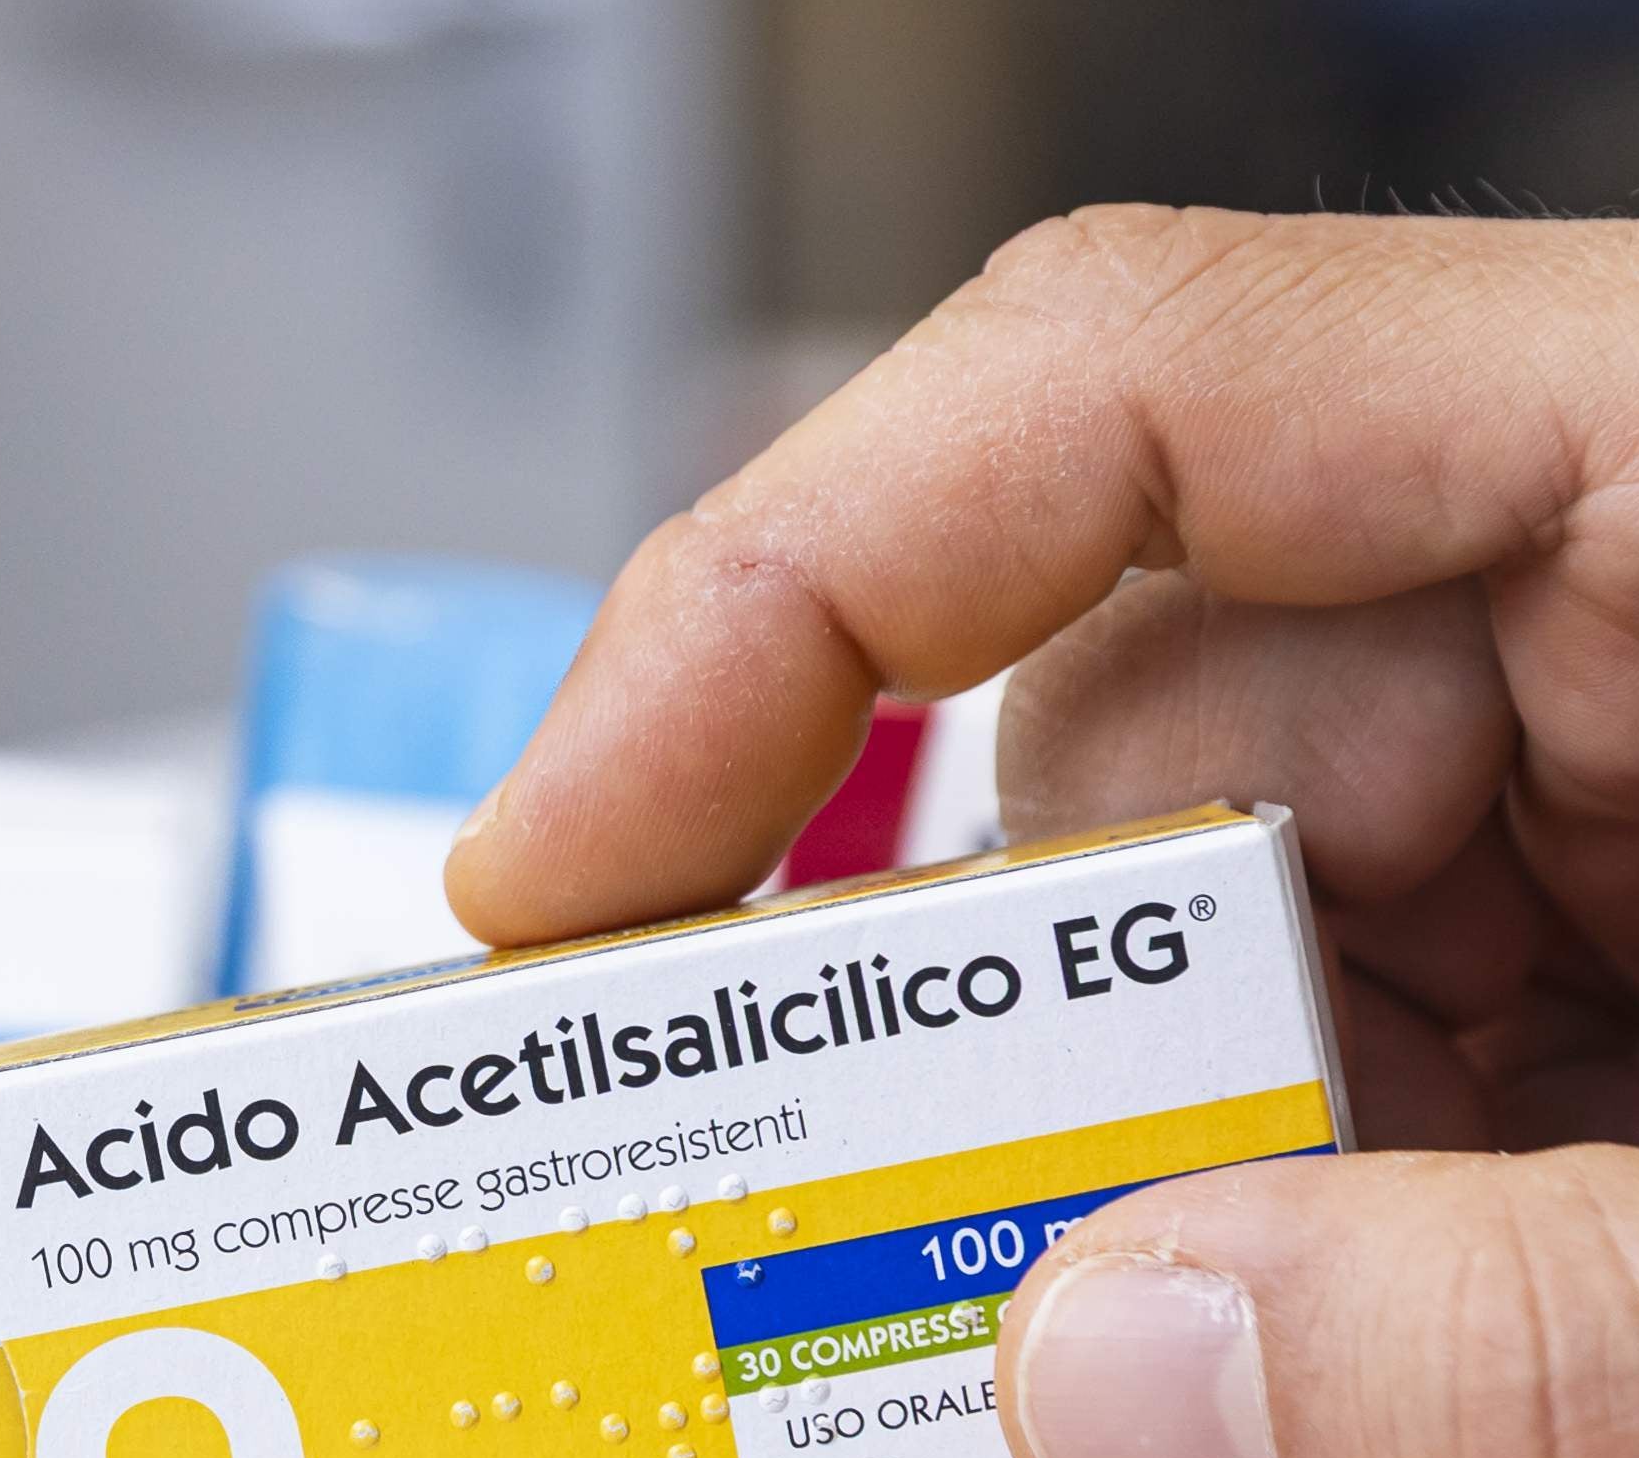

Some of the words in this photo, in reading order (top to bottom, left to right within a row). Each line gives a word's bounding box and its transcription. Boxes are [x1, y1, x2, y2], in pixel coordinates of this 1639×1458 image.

[16, 1088, 299, 1208] Acido
[336, 954, 1021, 1145] Acetilsalicilico
[32, 1238, 112, 1288] 100
[129, 1229, 199, 1271] mg
[214, 1179, 462, 1253] compresse
[477, 1098, 806, 1211] gastroresistenti
[921, 1219, 1025, 1282] 100
[737, 1347, 781, 1384] 30
[790, 1306, 990, 1375] COMPRESSE
[786, 1407, 865, 1451] USO
[877, 1381, 997, 1430] ORALE
